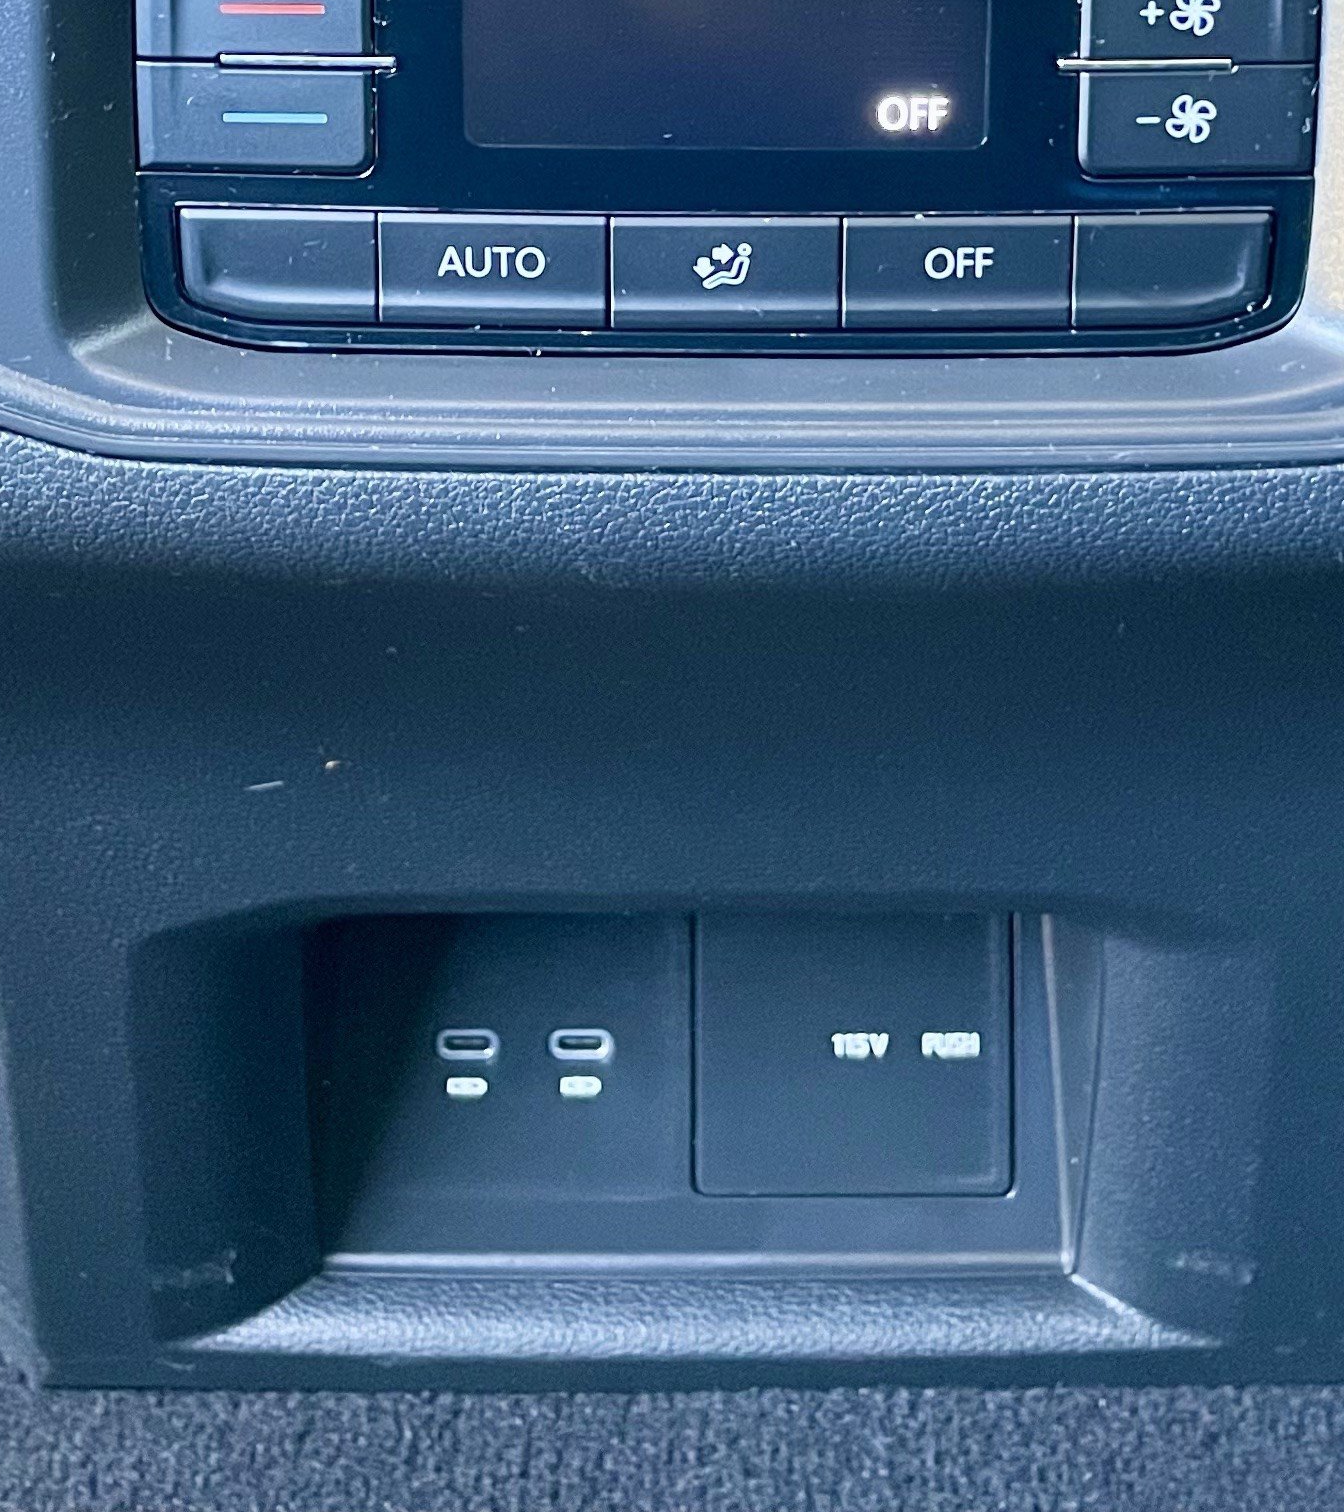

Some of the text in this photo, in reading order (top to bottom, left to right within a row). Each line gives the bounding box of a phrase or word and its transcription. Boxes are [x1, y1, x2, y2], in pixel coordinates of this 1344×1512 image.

[876, 94, 950, 131] OFF
[437, 245, 546, 279] AUTO
[924, 246, 994, 280] OFF
